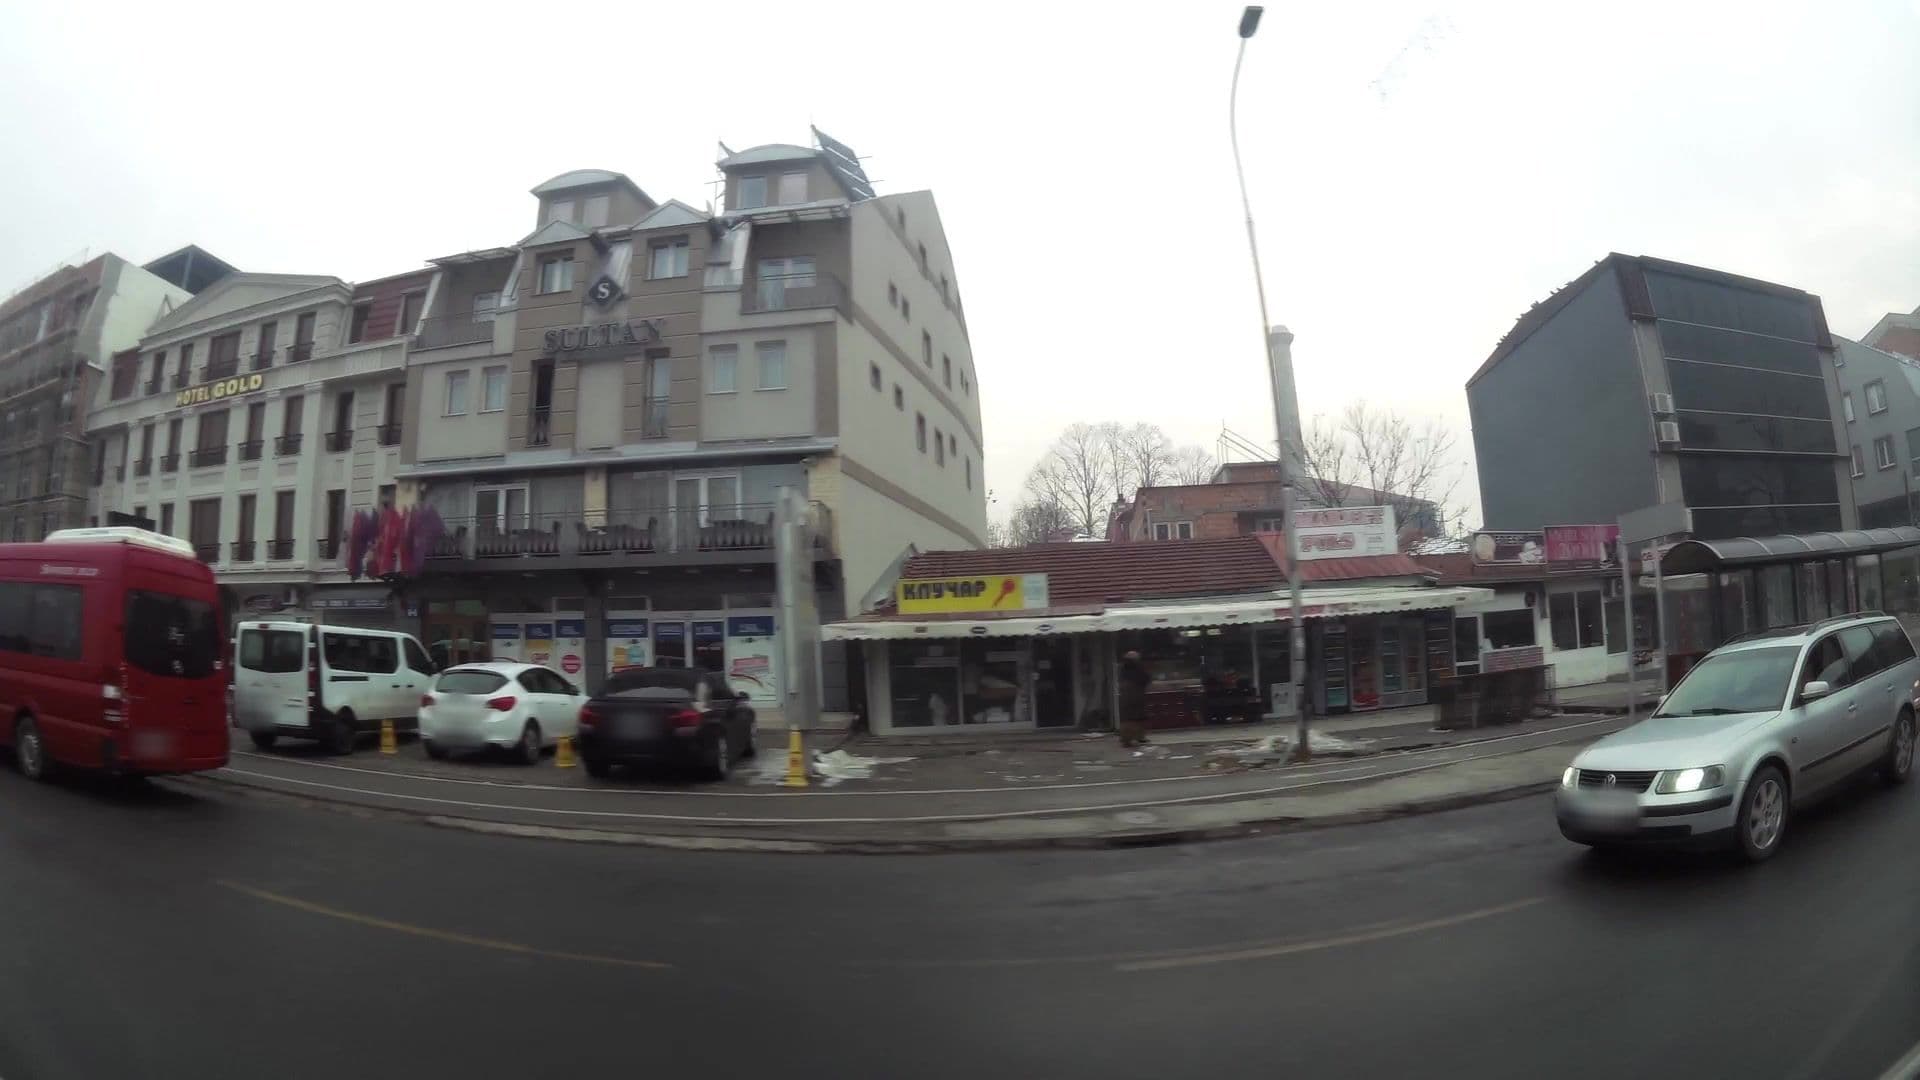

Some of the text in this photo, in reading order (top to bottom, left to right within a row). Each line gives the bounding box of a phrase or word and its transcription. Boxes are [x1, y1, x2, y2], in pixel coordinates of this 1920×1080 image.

[597, 282, 610, 299] S
[544, 319, 662, 352] SULTAN
[176, 374, 262, 407] HOTEL GOLD
[903, 580, 986, 600] КЛУЧАР
